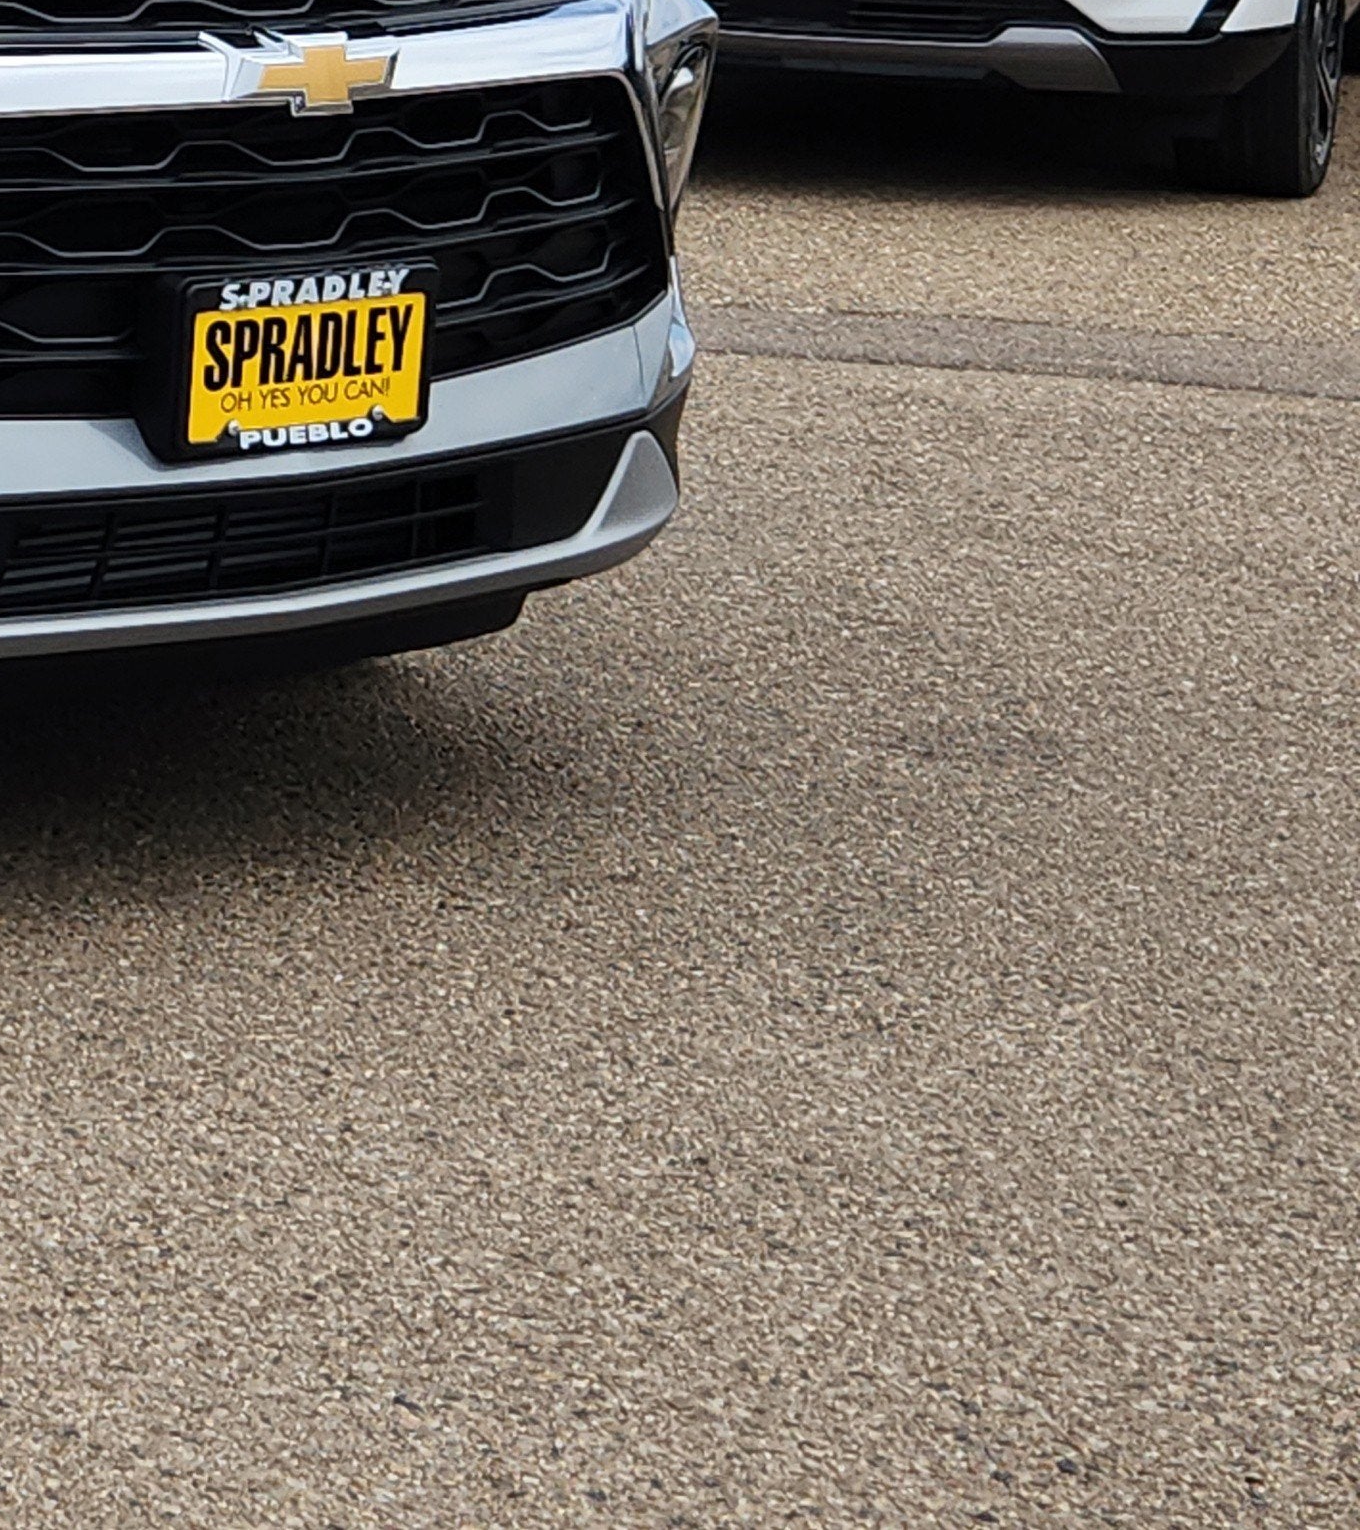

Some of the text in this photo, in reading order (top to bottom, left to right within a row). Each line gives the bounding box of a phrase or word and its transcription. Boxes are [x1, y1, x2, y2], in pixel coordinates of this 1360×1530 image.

[219, 269, 410, 310] SPRADLEY
[203, 303, 414, 391] SPRADLEY
[221, 390, 252, 413] OH
[259, 387, 291, 409] YES
[297, 382, 339, 406] YOU
[239, 418, 373, 450] PUEBLO
